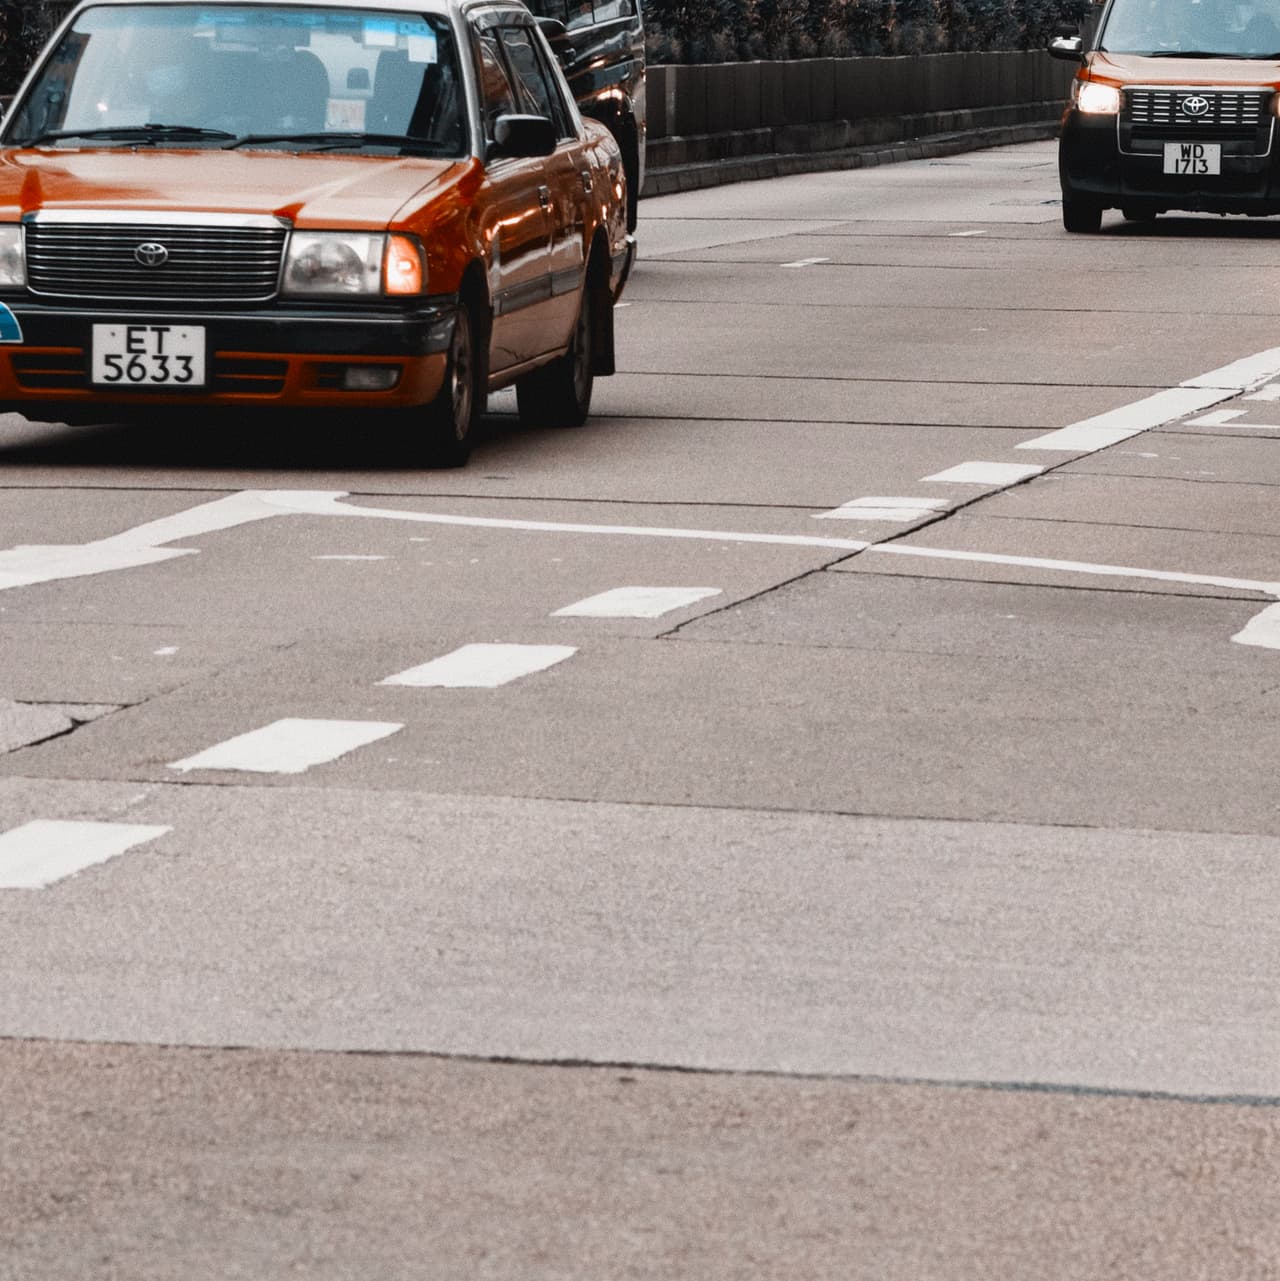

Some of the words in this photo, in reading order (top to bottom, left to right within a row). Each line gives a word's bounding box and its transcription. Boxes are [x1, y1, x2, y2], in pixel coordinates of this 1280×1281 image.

[1180, 144, 1204, 158] WD
[1175, 159, 1209, 174] 1713
[126, 327, 171, 355] ET
[102, 355, 195, 384] 5633
